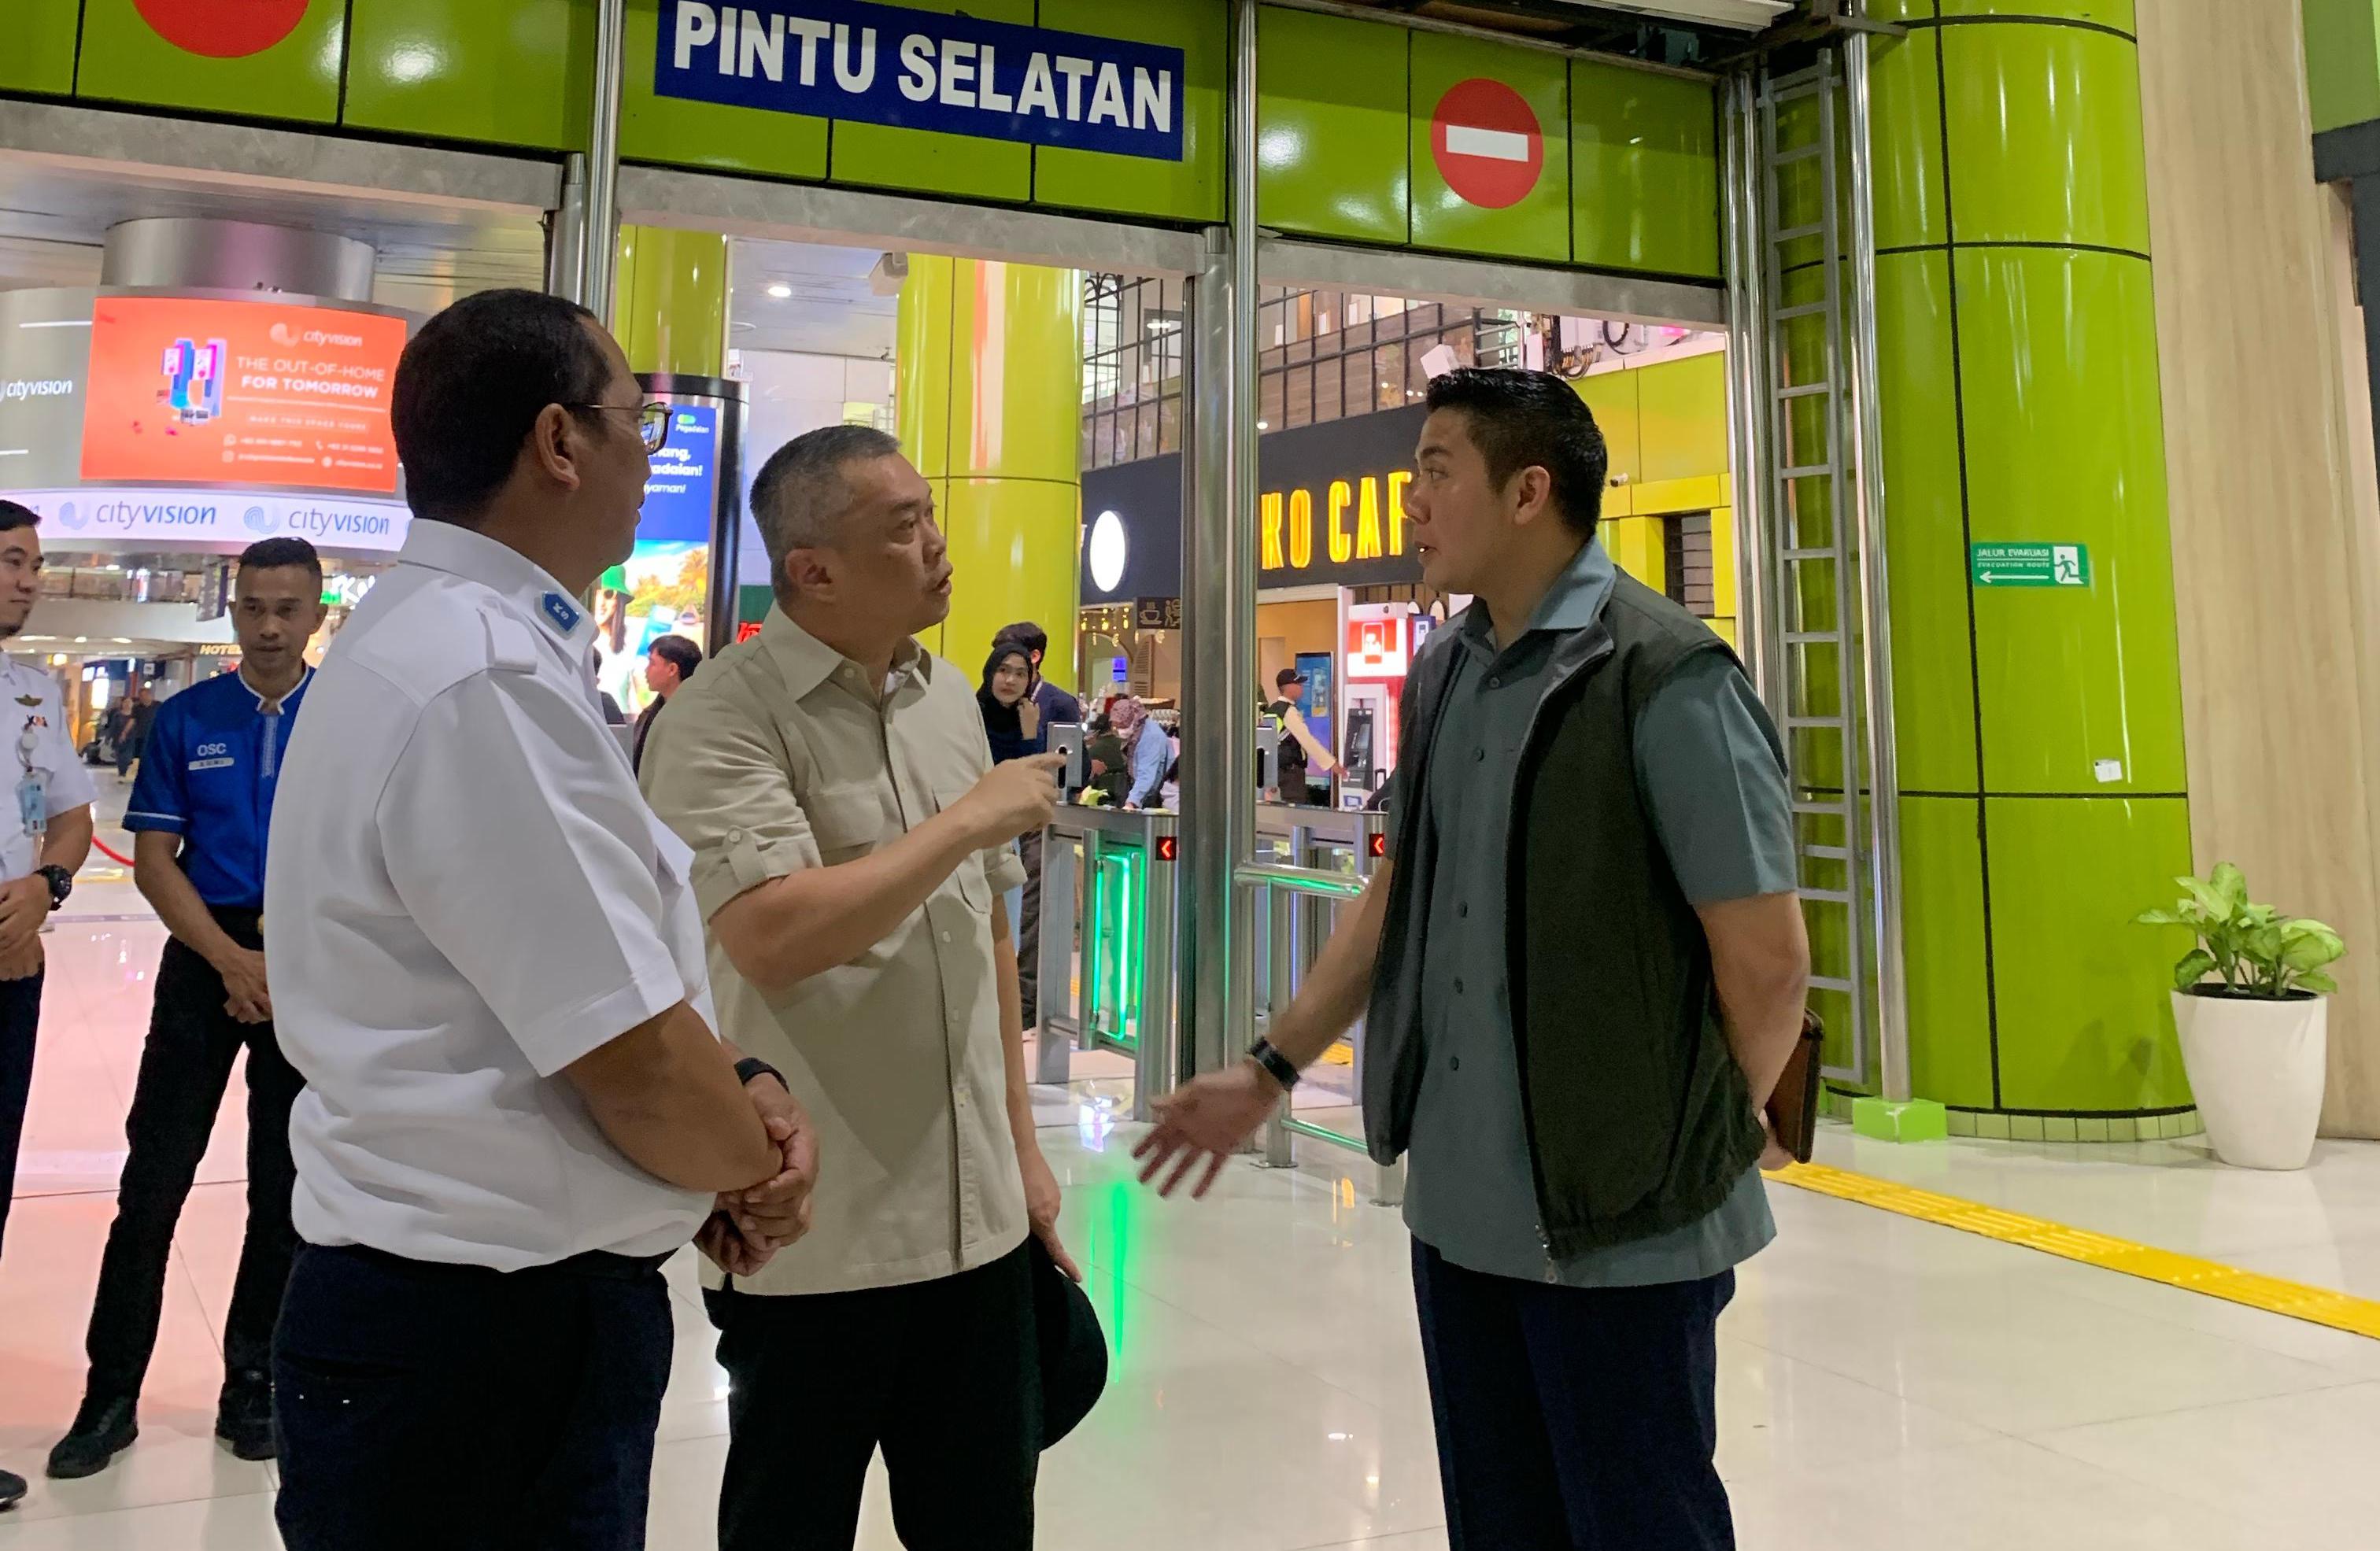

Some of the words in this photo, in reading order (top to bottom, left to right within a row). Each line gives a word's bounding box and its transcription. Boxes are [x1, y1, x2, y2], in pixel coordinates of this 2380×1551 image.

[674, 0, 877, 93] PINTU
[897, 34, 1171, 132] SELATAN
[303, 330, 363, 346] cityvision
[237, 356, 269, 371] THE
[273, 359, 385, 382] OUT-OF-HOME
[6, 379, 73, 401] cityvision
[241, 375, 277, 390] FOR
[282, 378, 379, 398] TOMORROW
[96, 500, 216, 530] cityvision
[288, 508, 390, 537] cityvision
[1976, 548, 2006, 557] JALUR
[2008, 548, 2049, 557] EVAKUASI
[197, 742, 227, 757] OSC
